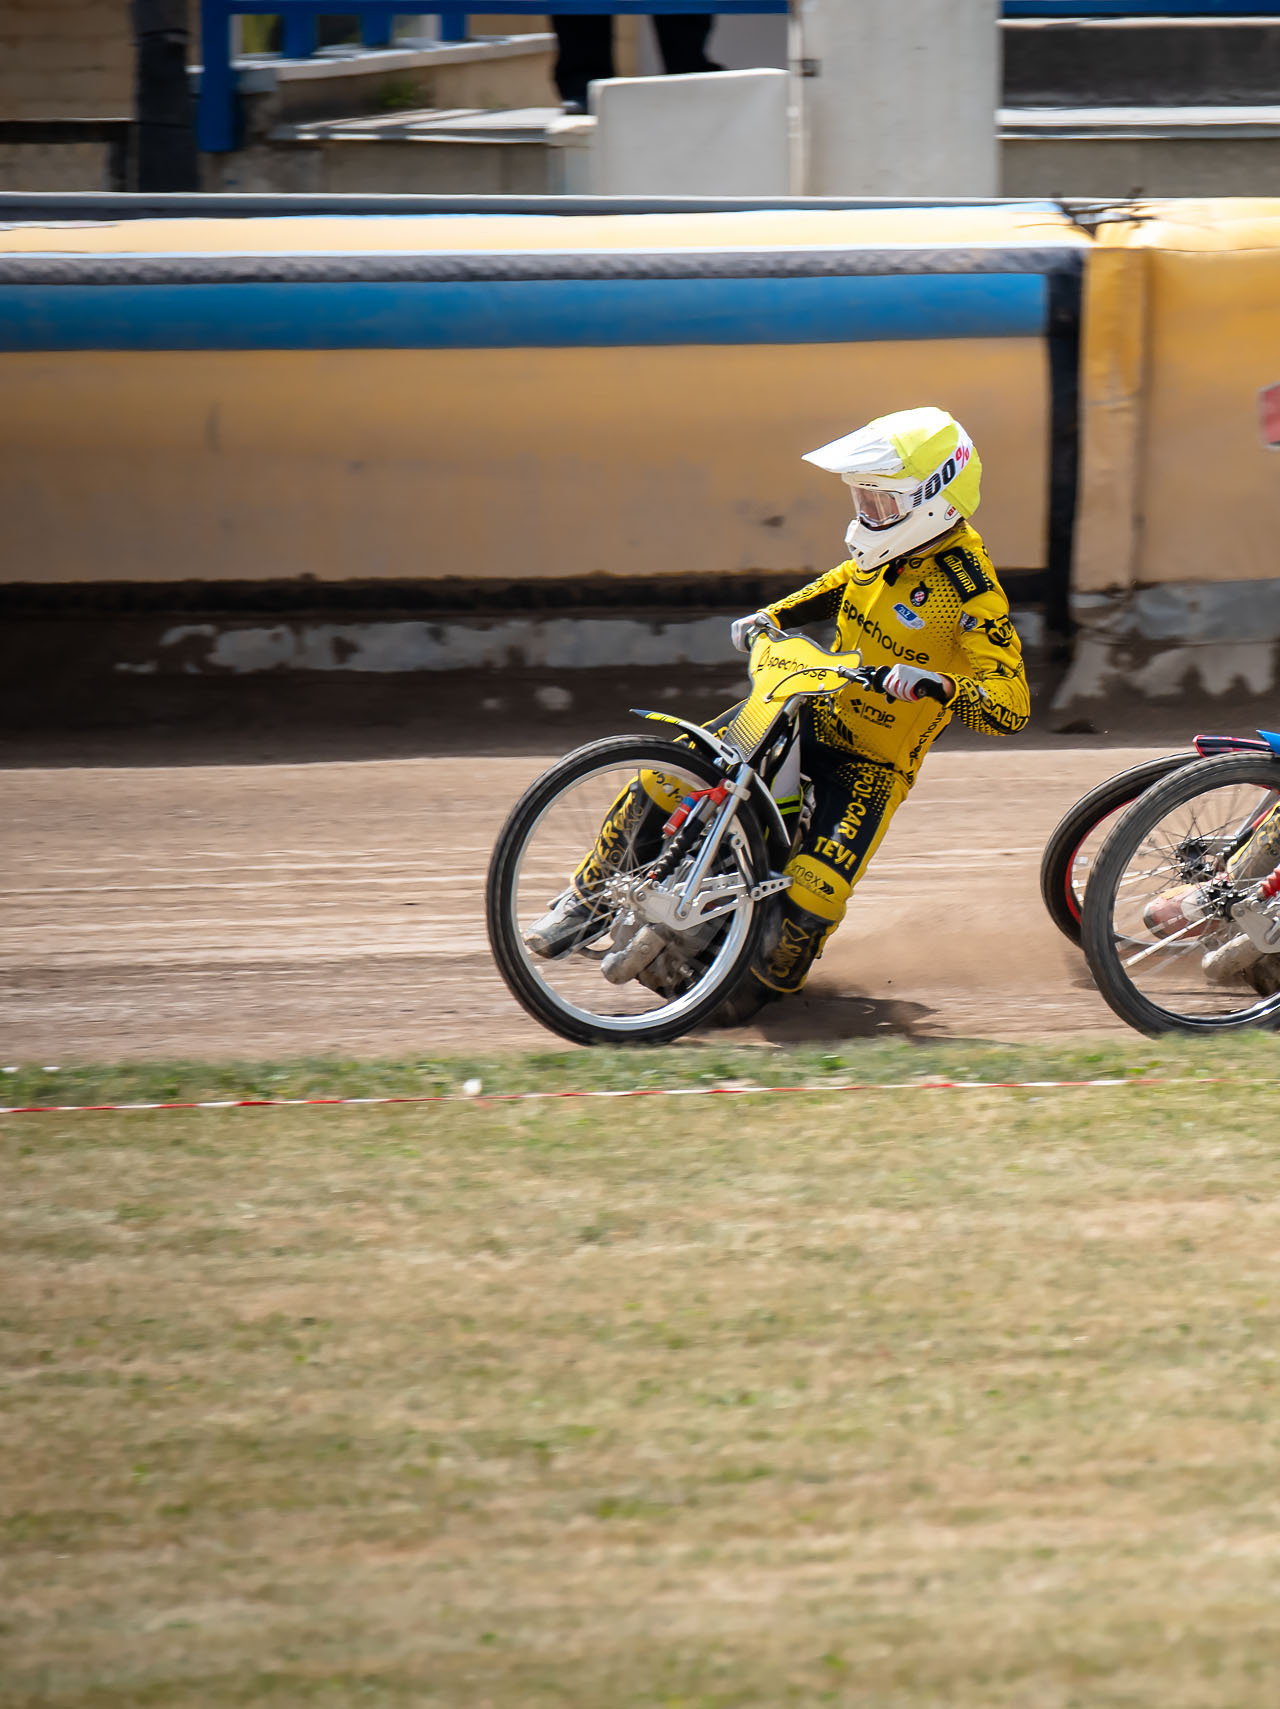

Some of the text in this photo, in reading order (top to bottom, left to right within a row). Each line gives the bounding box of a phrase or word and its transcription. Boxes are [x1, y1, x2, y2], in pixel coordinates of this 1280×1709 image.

[909, 442, 970, 508] 100%
[843, 598, 931, 665] spechouse
[768, 656, 827, 681] spechouse
[792, 864, 821, 887] mex
